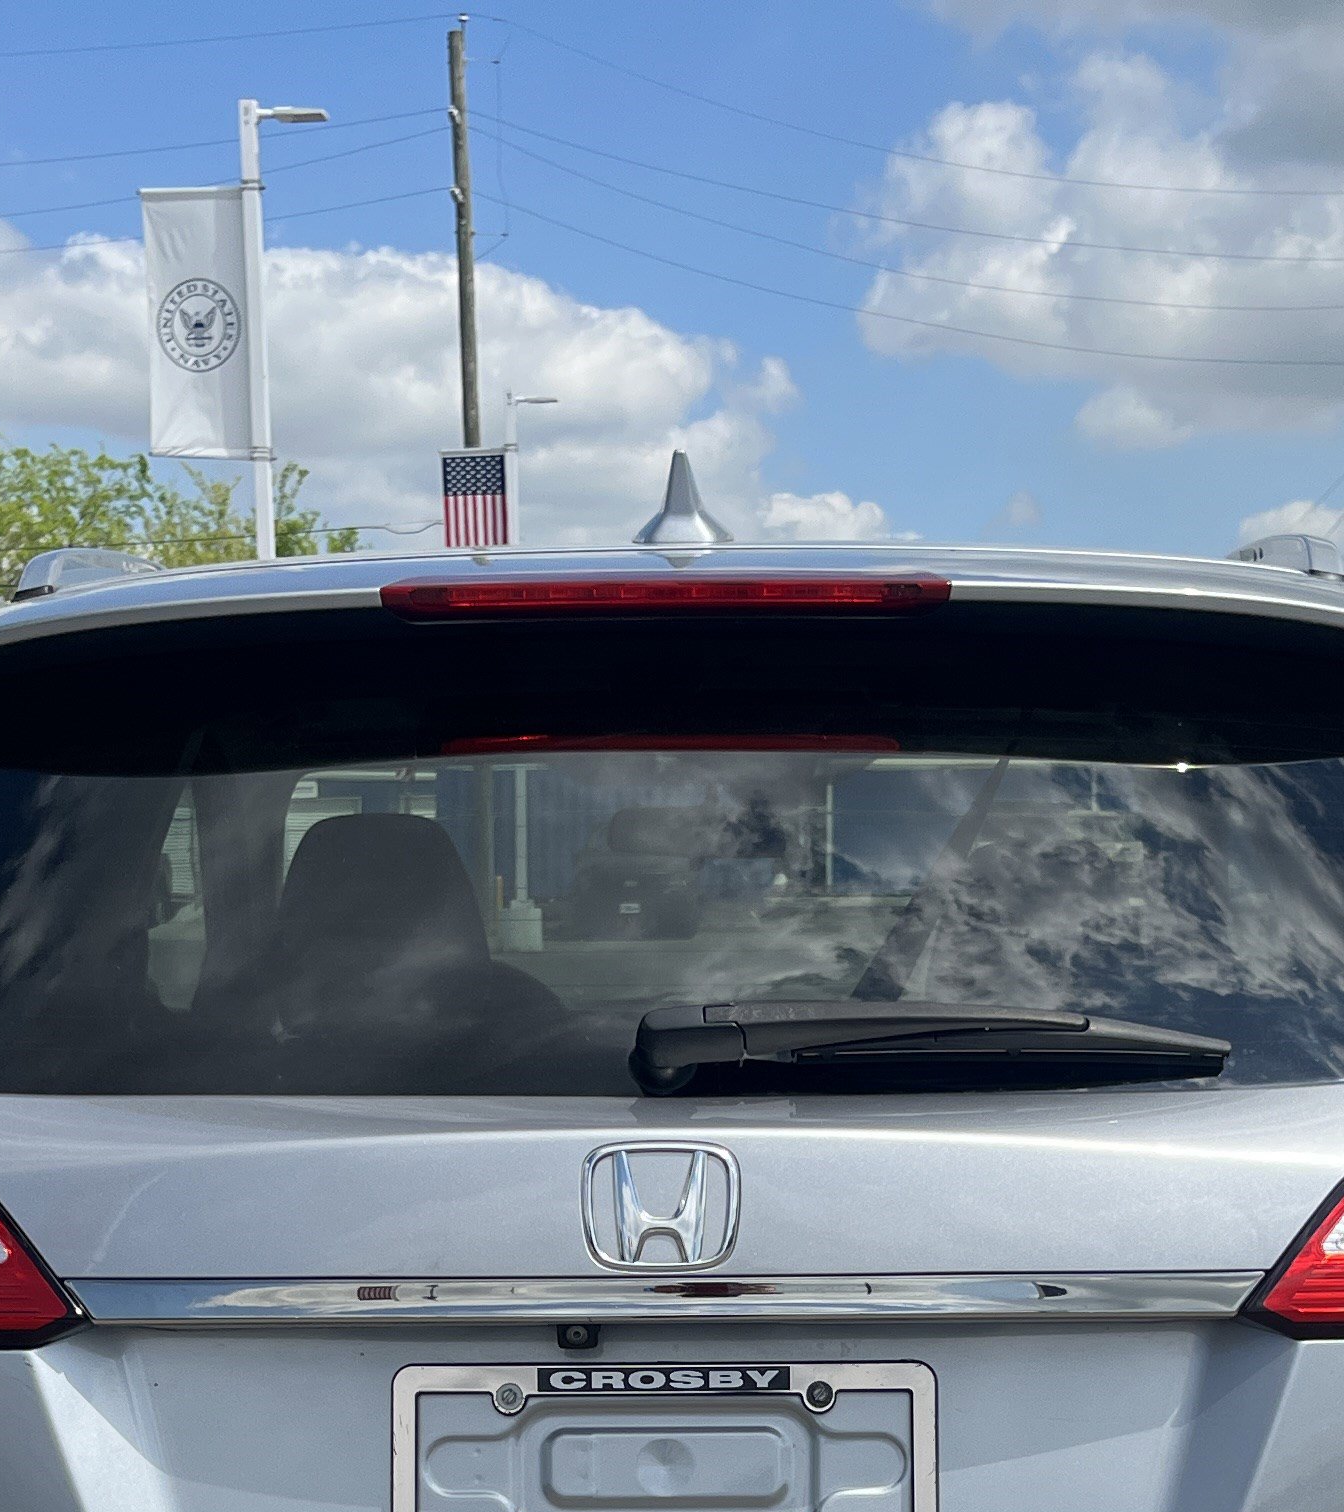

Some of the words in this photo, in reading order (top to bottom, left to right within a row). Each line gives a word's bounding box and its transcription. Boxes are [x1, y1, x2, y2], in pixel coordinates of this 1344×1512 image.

[161, 283, 198, 343] UNITED
[179, 353, 222, 368] NAVY
[549, 1369, 780, 1390] CROSBY
